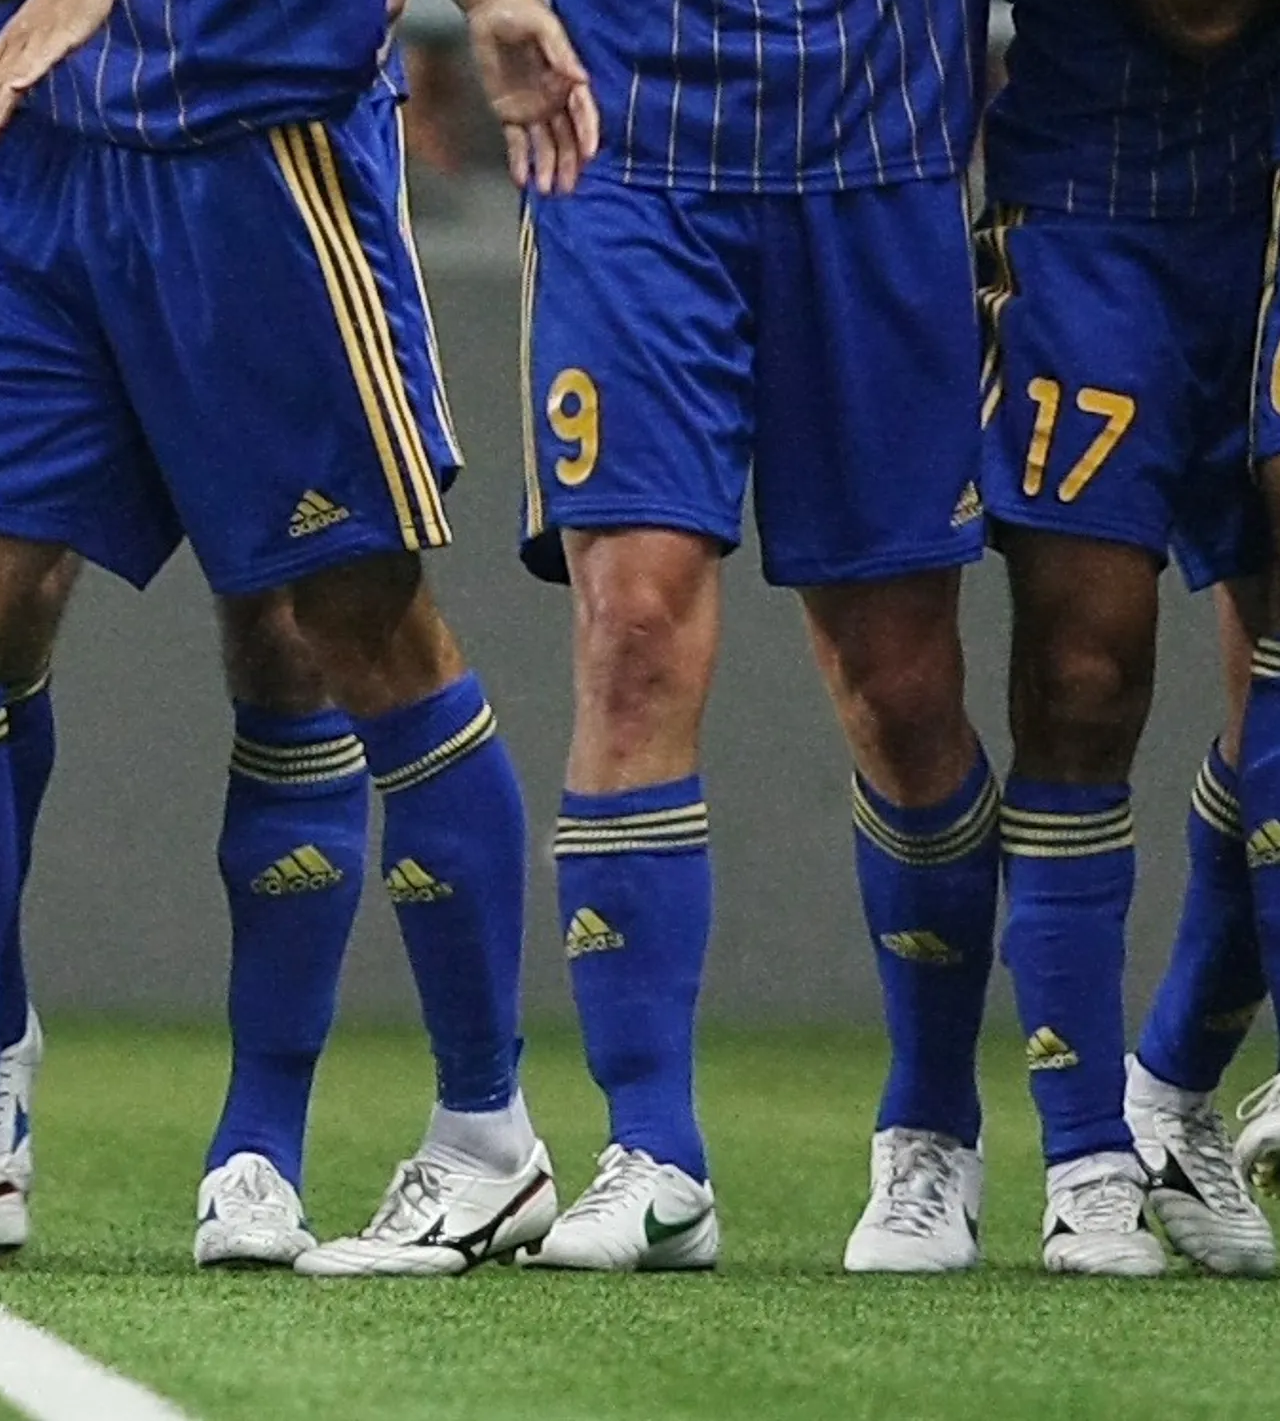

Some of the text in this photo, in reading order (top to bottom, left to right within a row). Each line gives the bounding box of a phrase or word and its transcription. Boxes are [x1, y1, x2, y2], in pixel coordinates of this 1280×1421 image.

[547, 367, 600, 487] 9
[1022, 377, 1136, 503] 17
[288, 506, 351, 538] adidas
